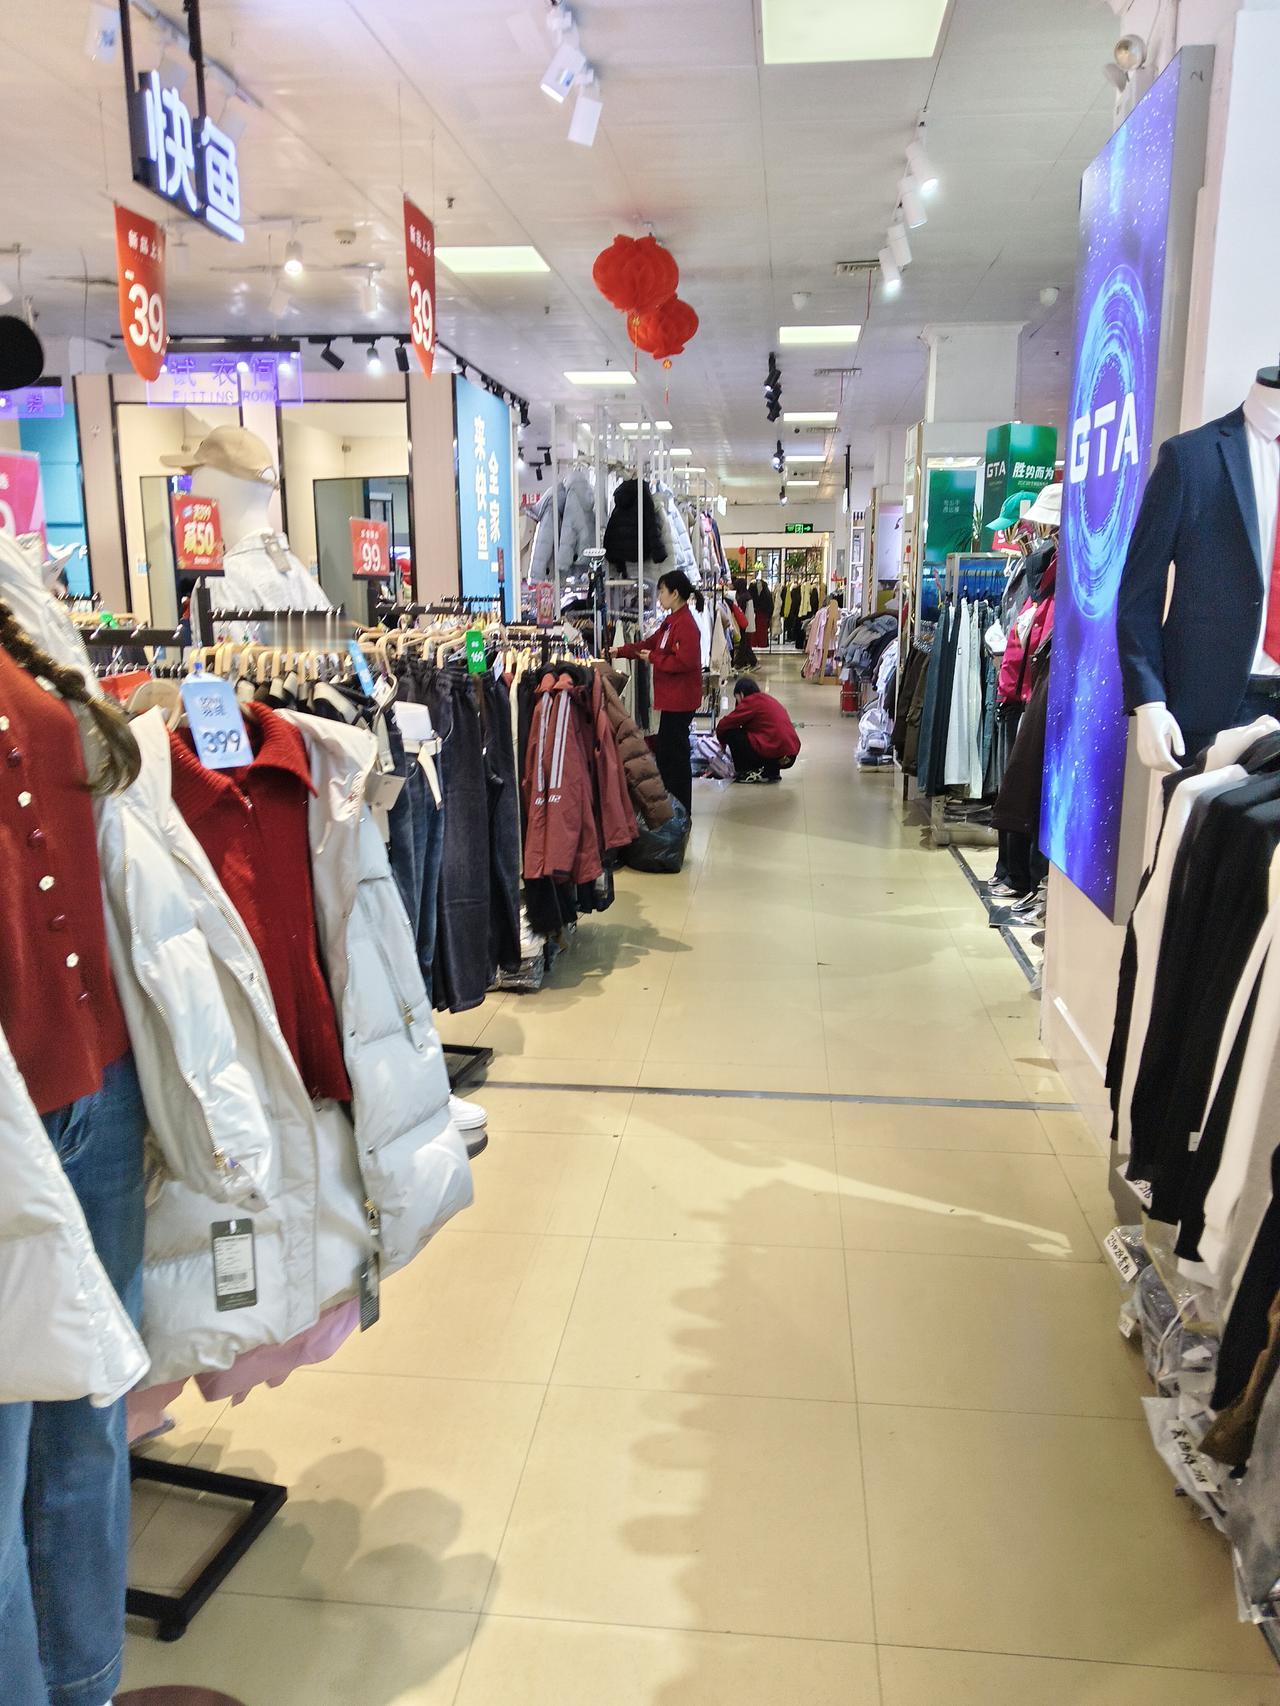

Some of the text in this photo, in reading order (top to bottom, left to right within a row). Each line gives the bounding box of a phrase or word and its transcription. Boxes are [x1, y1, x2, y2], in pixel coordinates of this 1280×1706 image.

[145, 69, 245, 243] 快鱼
[128, 283, 164, 354] 39
[410, 279, 433, 352] 39
[171, 358, 276, 387] 试衣间
[173, 389, 278, 403] FITTING ROOM
[1069, 391, 1139, 484] GTA
[986, 461, 1006, 478] GTA
[362, 543, 381, 571] 99
[203, 729, 241, 753] 399
